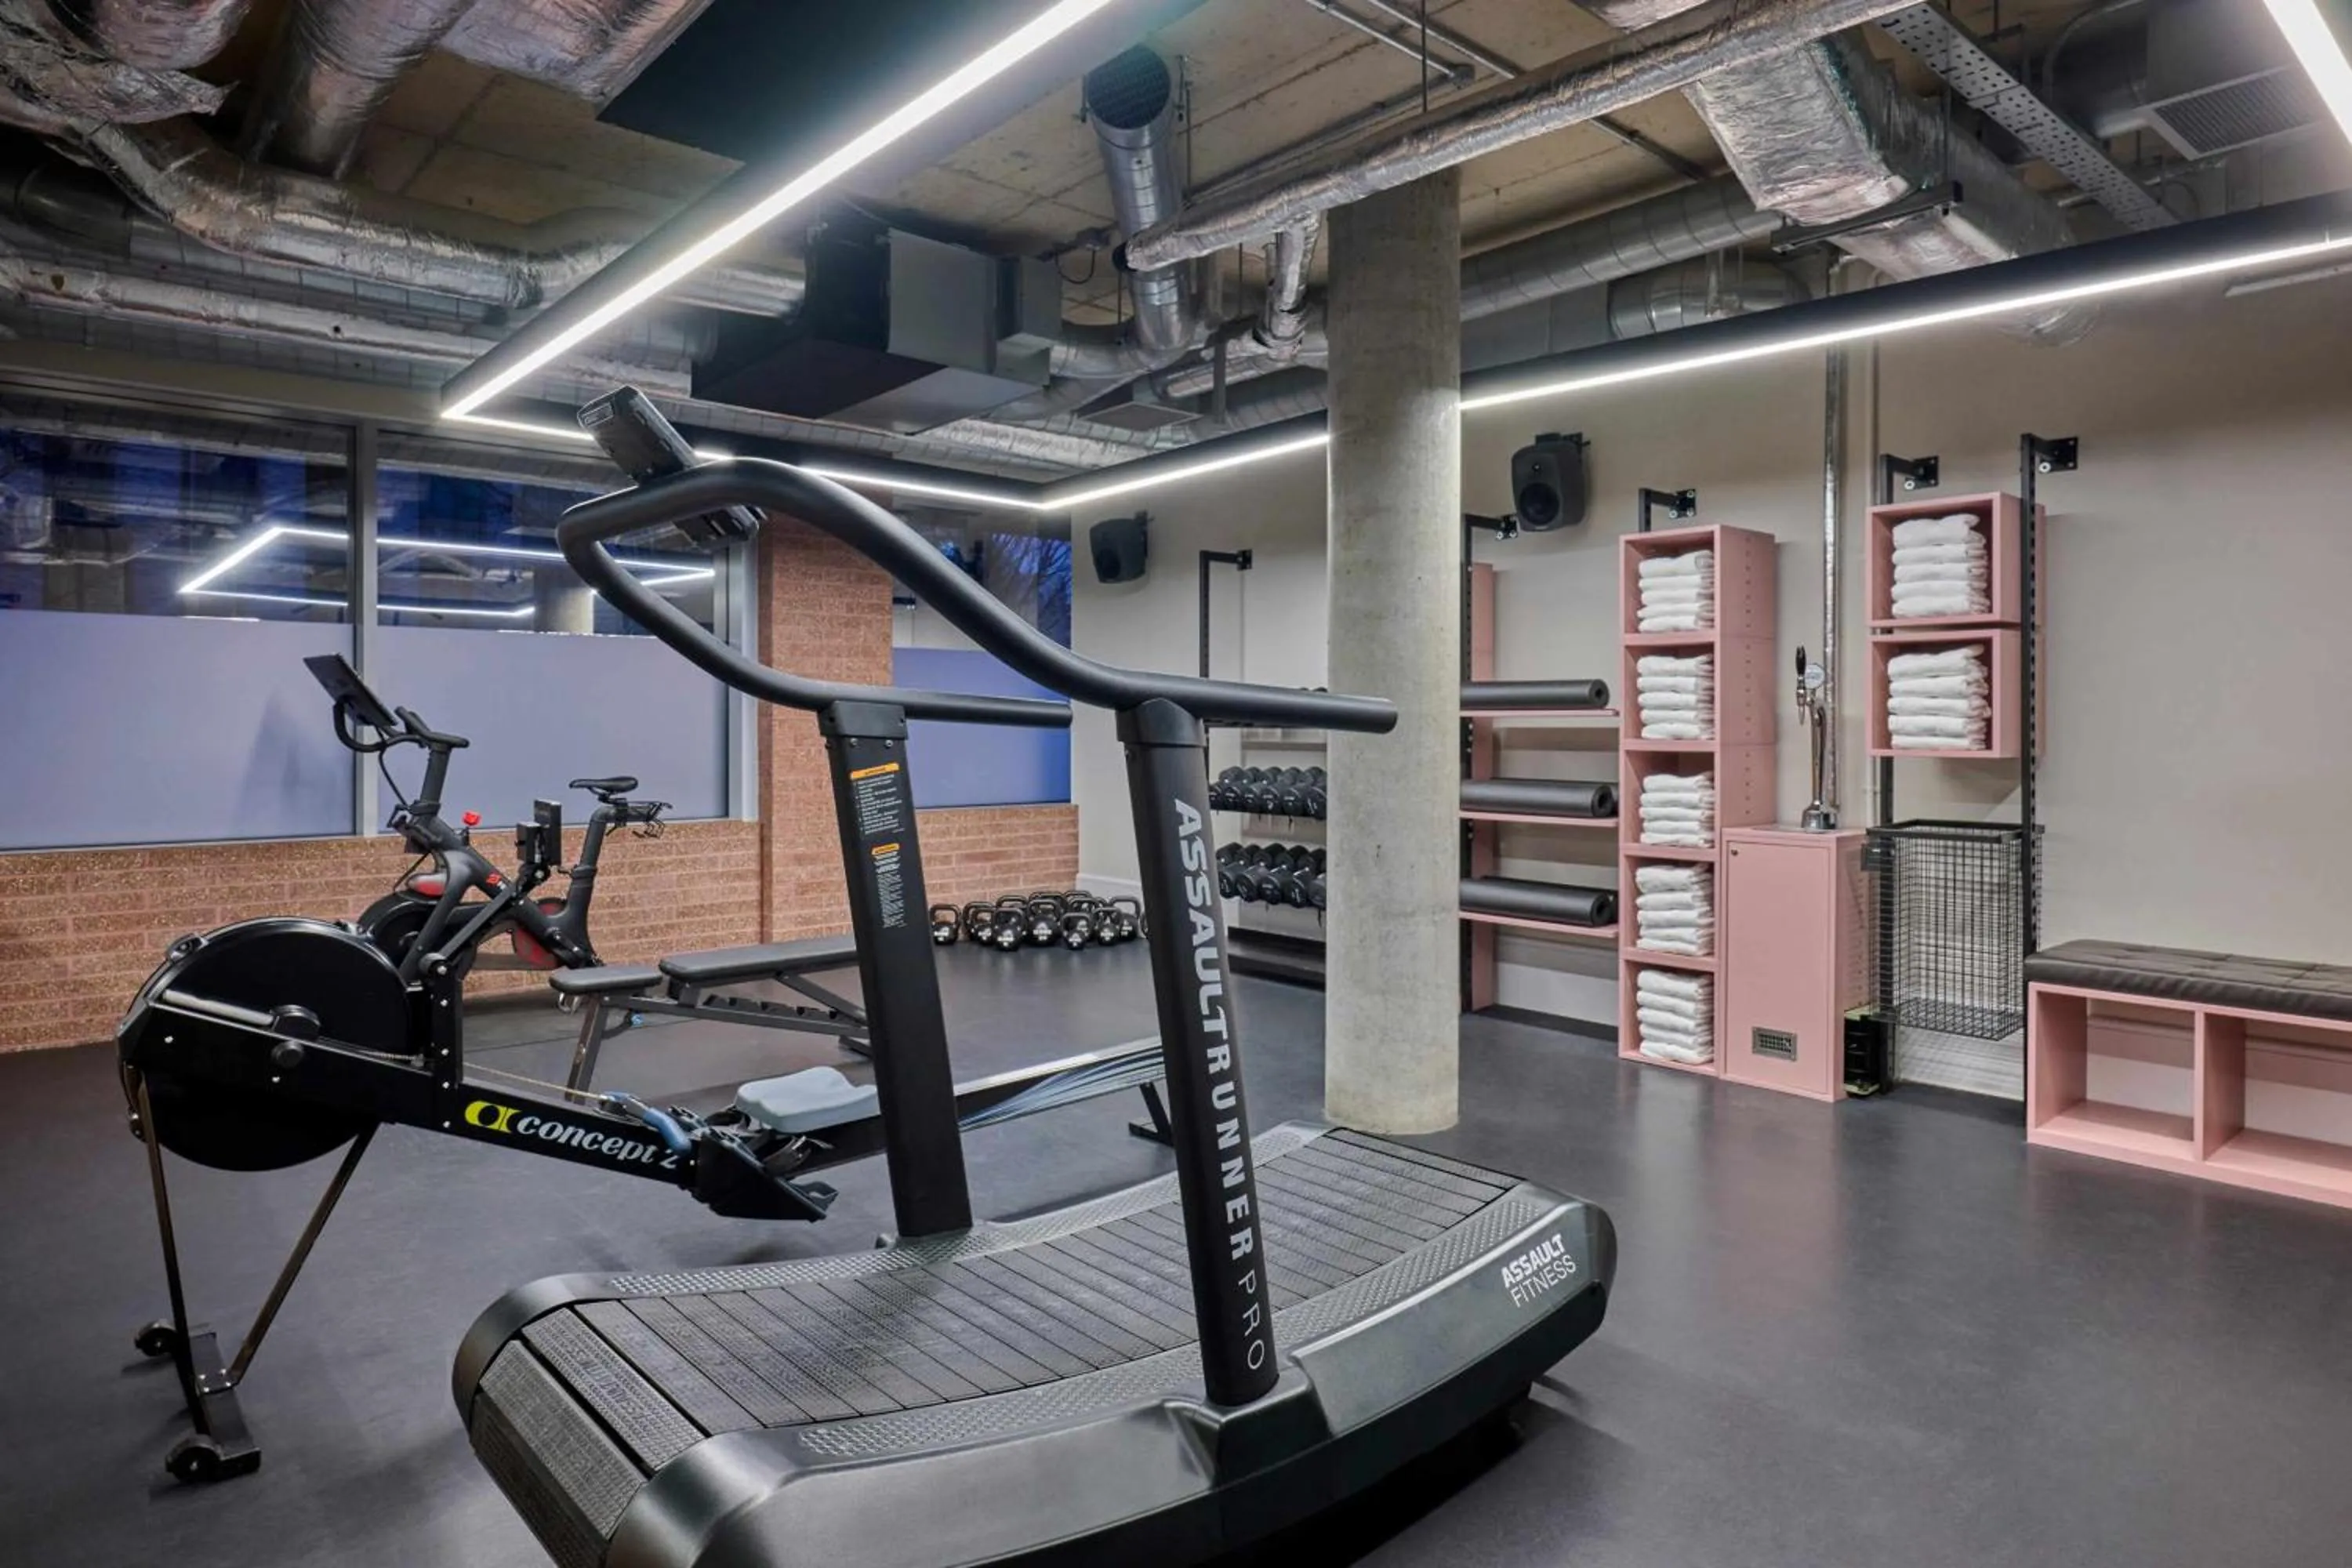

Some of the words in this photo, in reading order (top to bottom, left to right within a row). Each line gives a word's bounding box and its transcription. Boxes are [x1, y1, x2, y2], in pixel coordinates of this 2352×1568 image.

[517, 1116, 658, 1162] concept
[1501, 1234, 1566, 1288] ASSAULT
[1509, 1254, 1577, 1308] FITNESS
[1238, 1269, 1265, 1370] PRO
